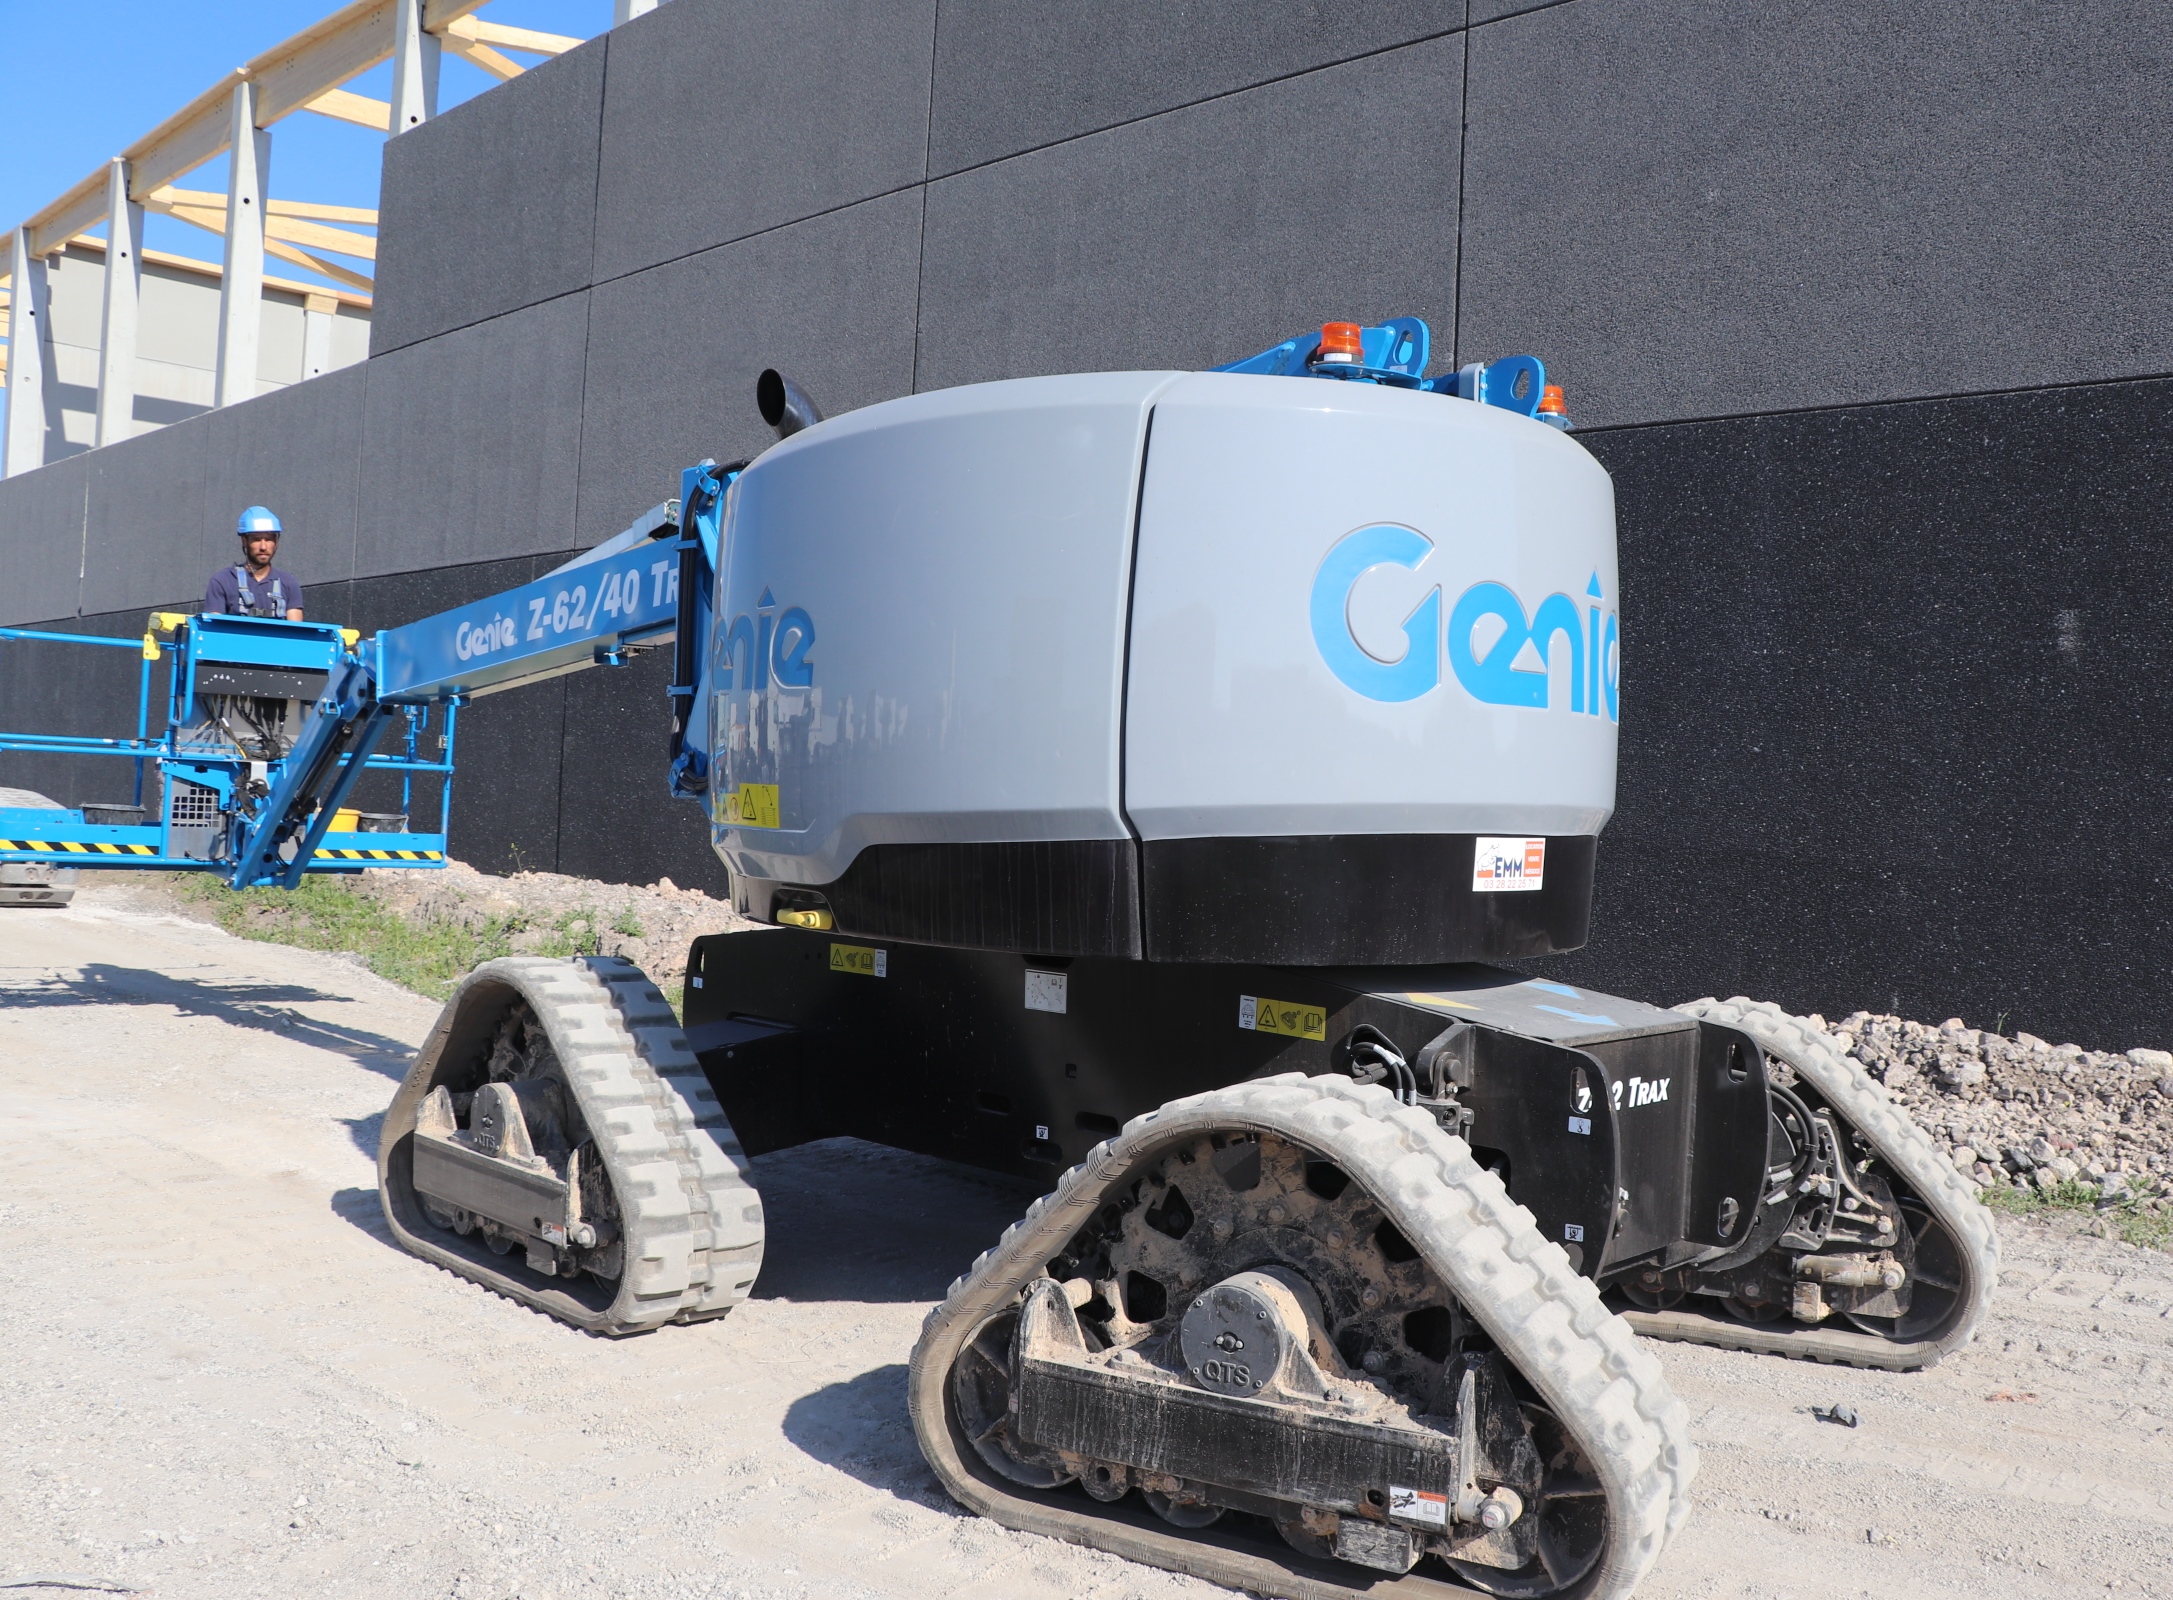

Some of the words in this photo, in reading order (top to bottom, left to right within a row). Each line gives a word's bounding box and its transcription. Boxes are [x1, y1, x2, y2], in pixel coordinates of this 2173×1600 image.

[456, 612, 516, 661] Genie
[526, 569, 640, 641] Z-62/40
[1494, 857, 1523, 877] EMM
[1484, 879, 1494, 889] 03
[1496, 879, 1506, 889] 28
[1507, 879, 1516, 888] 22
[1517, 879, 1526, 888] 25
[1528, 879, 1536, 888] 71
[1628, 1076, 1670, 1108] TRAX
[1202, 1359, 1250, 1387] QTS
